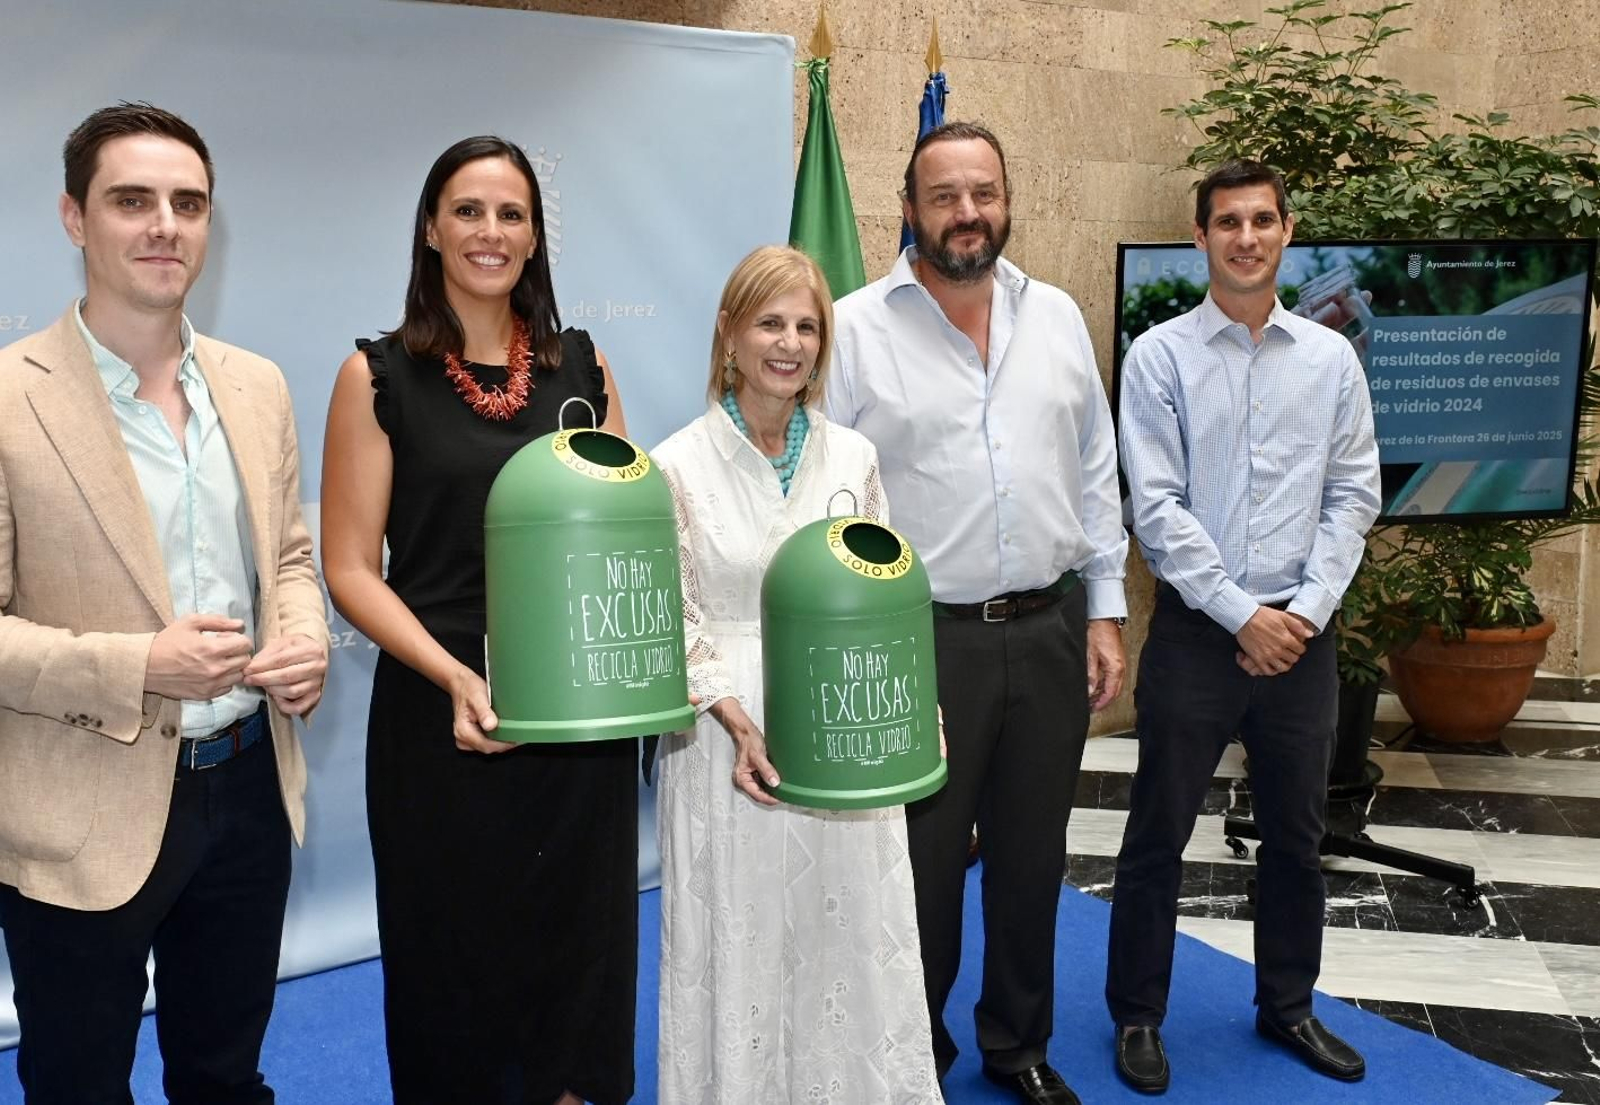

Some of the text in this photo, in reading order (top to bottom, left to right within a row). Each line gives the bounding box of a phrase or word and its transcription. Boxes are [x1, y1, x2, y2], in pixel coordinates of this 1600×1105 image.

[1426, 260, 1482, 269] Ayuntamiento
[1495, 259, 1516, 269] Jerez
[572, 300, 597, 318] de
[605, 301, 656, 322] Jerez
[1373, 326, 1507, 343] Presentación de
[1372, 349, 1560, 367] resultados de recogida
[1371, 374, 1560, 390] de residuos de envases
[1371, 398, 1483, 414] de vidrio 2024
[1398, 435, 1413, 445] de
[1414, 434, 1425, 445] la
[1427, 433, 1475, 444] Frontera
[1476, 432, 1490, 443] 26
[1491, 431, 1506, 442] de
[1507, 430, 1535, 444] junio
[1536, 430, 1563, 440] 2025
[566, 456, 610, 478] SOLO
[843, 543, 912, 576] SOLO VIDRIO
[606, 556, 652, 590] NO HAY
[581, 588, 672, 641] EXCUSAS
[587, 645, 674, 682] RECICLA VIDRIO
[842, 650, 889, 681] NO HAY
[820, 674, 912, 723] EXCUSAS
[826, 724, 912, 759] RECICLA VIDRIO
